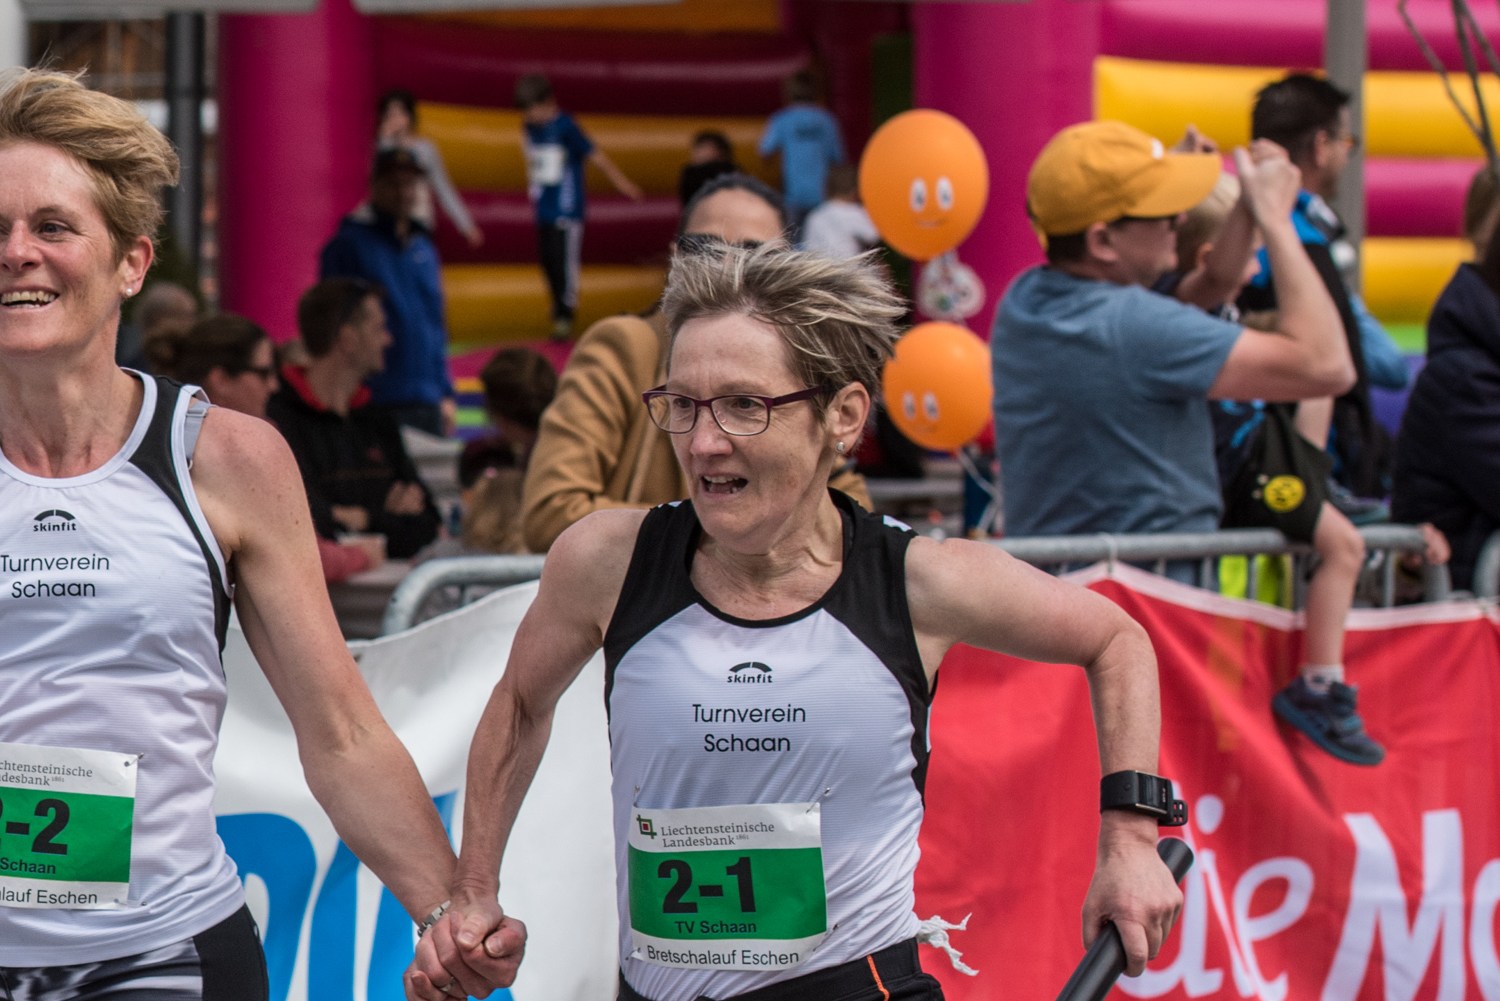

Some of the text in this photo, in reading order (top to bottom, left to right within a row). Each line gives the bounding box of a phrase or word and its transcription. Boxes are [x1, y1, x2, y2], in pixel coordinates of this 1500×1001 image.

[33, 522, 77, 532] skinfit
[0, 553, 110, 572] Turnverein
[11, 580, 96, 599] Schaan
[727, 674, 773, 684] skinfit
[692, 703, 806, 723] Turnverein
[704, 733, 791, 752] Schaan
[661, 821, 775, 837] Liechtensteinische
[662, 834, 735, 848] Landesbank
[0, 856, 56, 875] Schaan
[657, 856, 756, 914] 2-1
[36, 889, 98, 905] Eschen
[674, 920, 757, 934] TV Schaan
[647, 945, 799, 966] Bretschalauf Eschen
